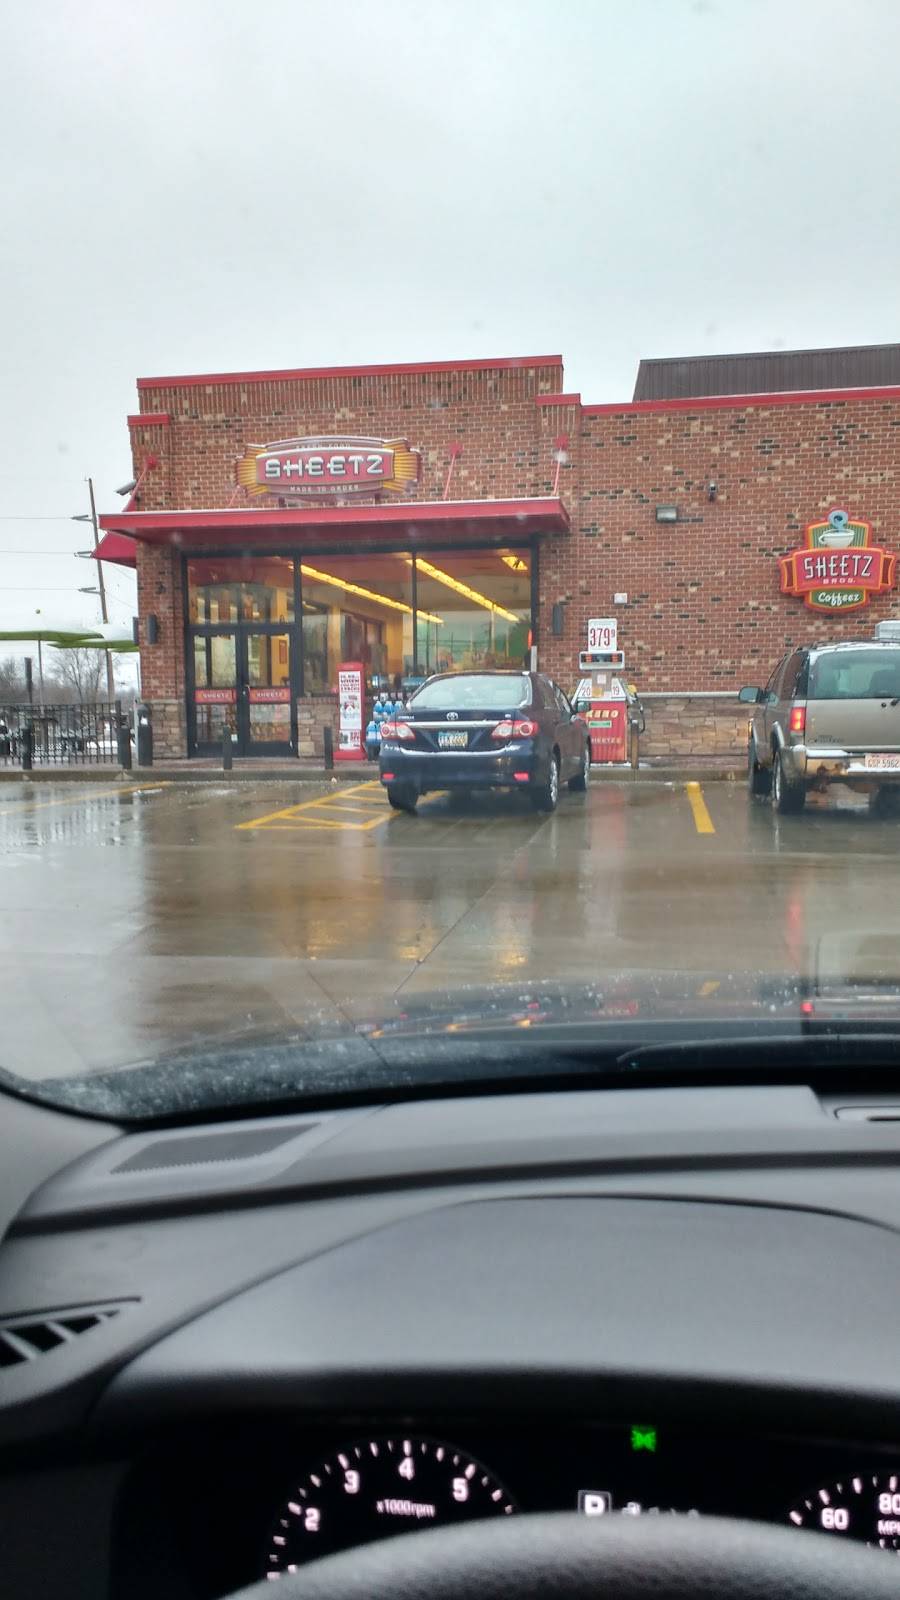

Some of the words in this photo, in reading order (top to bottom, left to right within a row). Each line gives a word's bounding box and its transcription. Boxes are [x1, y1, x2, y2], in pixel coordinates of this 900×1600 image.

[265, 454, 383, 478] SHEETZ
[803, 555, 873, 579] SHEETZ
[398, 1457, 414, 1480] 4
[344, 1470, 360, 1494] 3
[452, 1477, 468, 1502] 5
[304, 1507, 320, 1531] 2
[821, 1507, 848, 1530] 60
